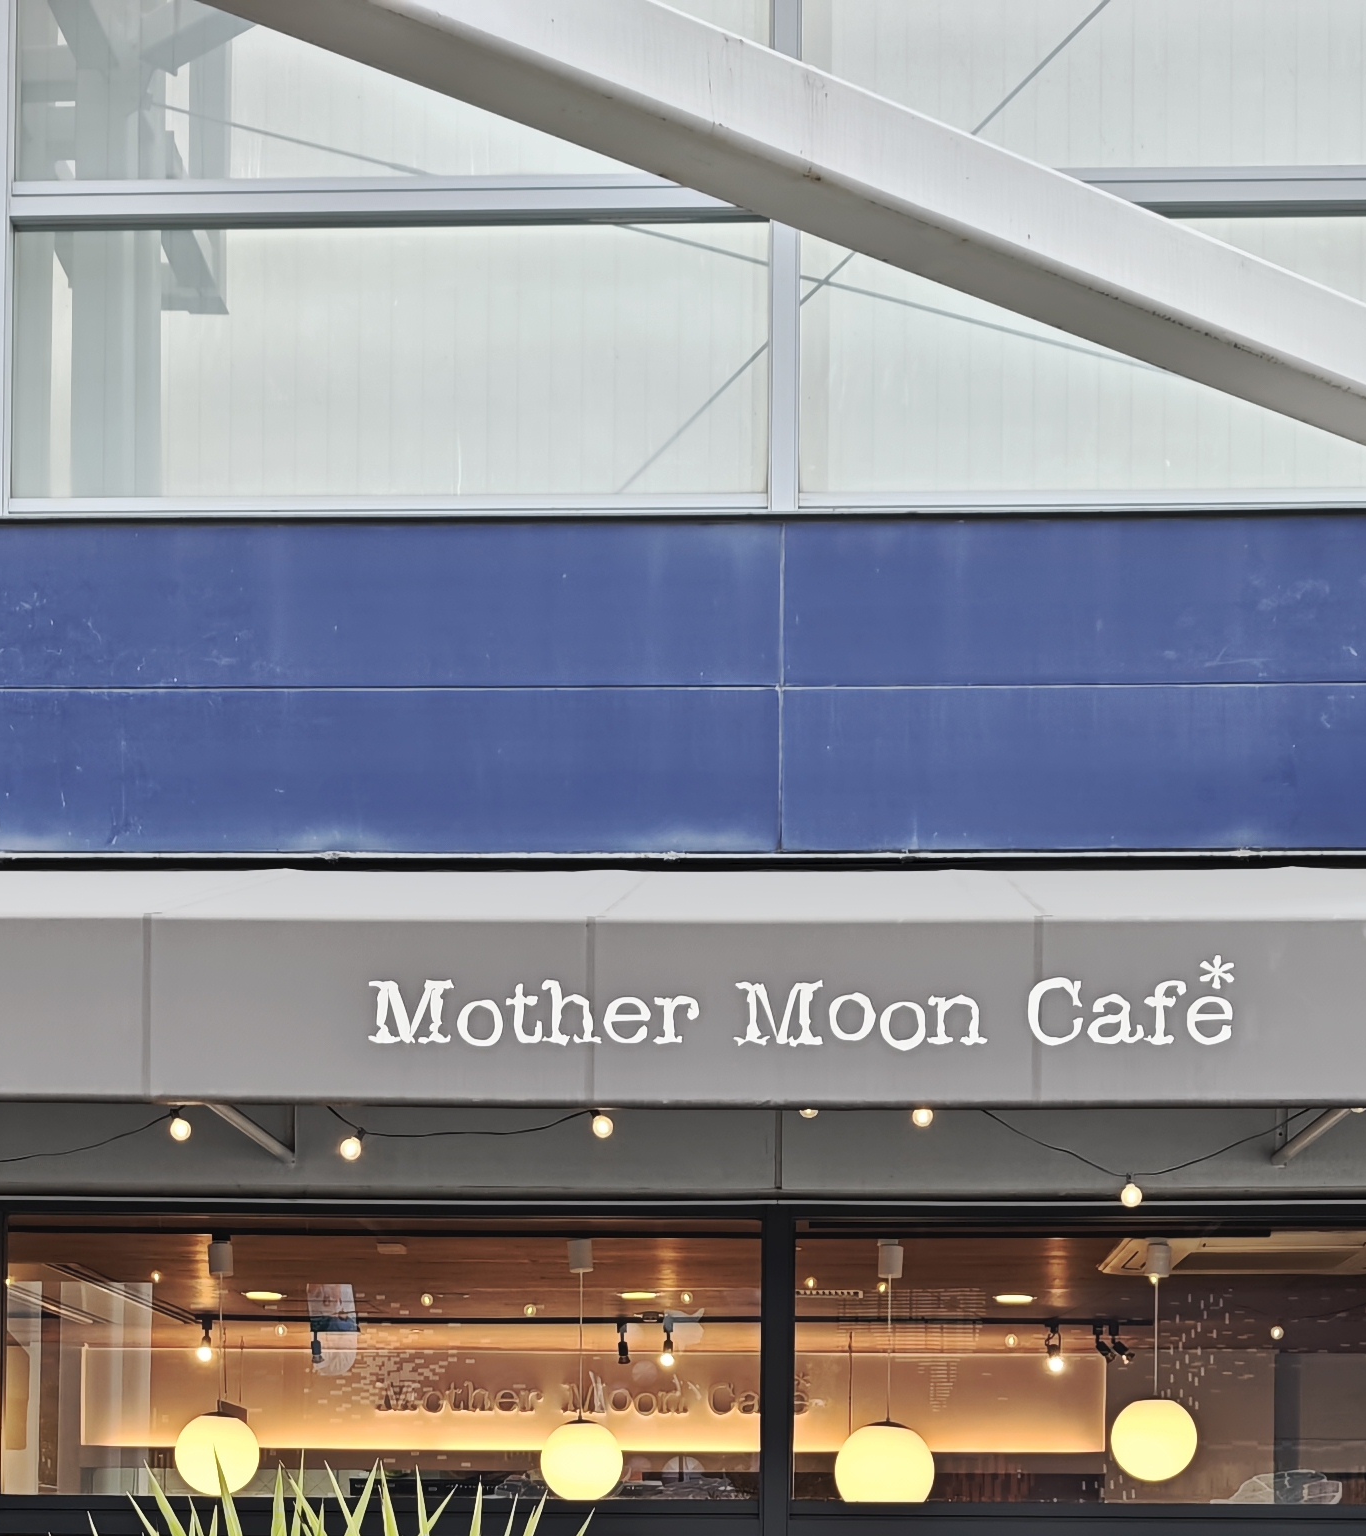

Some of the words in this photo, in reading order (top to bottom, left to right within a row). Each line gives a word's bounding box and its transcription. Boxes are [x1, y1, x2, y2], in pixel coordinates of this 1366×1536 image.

[368, 979, 700, 1047] Mother
[733, 979, 988, 1051] Moon
[375, 1381, 543, 1413] Mother
